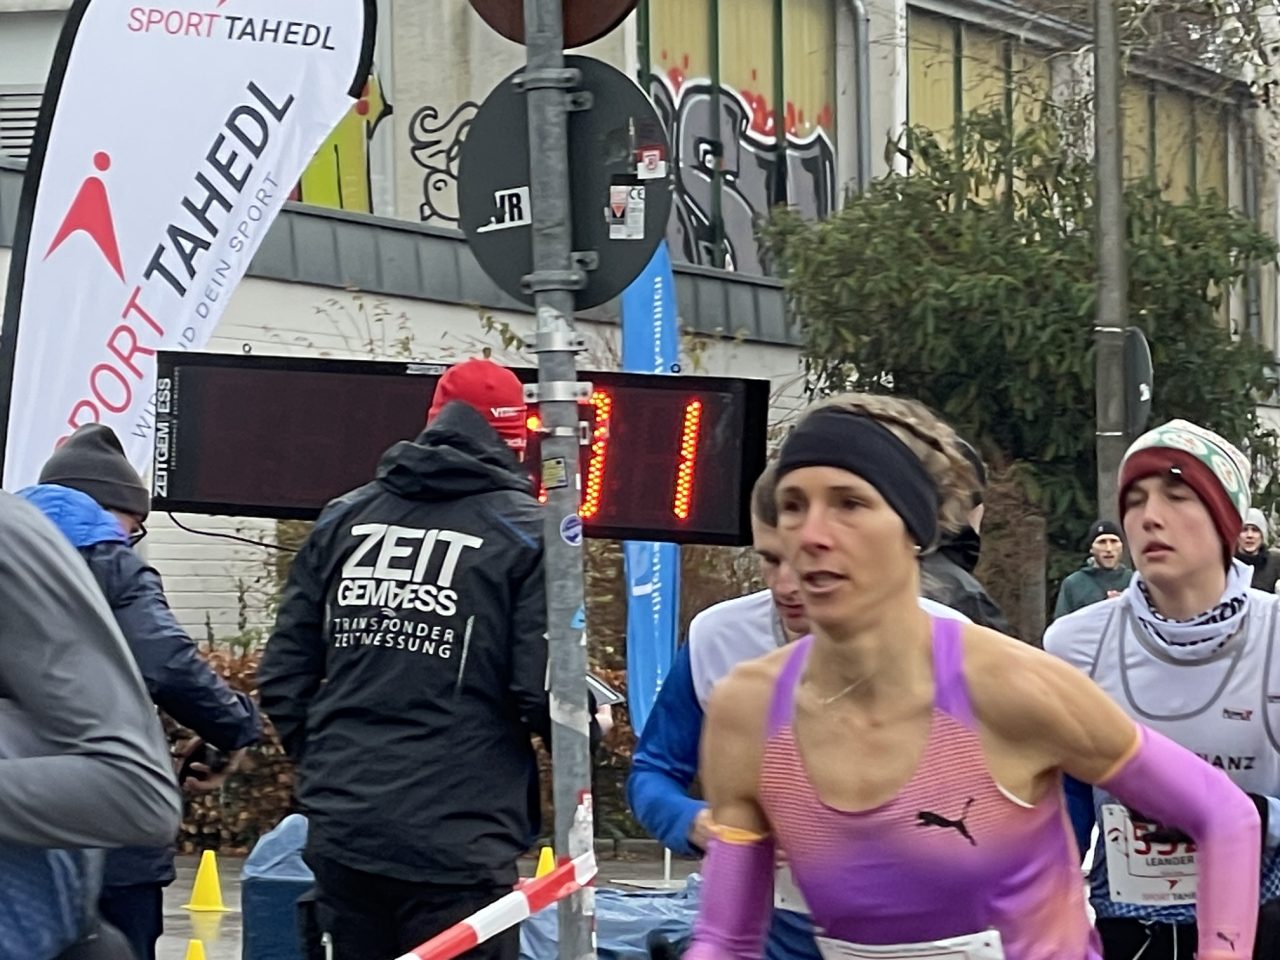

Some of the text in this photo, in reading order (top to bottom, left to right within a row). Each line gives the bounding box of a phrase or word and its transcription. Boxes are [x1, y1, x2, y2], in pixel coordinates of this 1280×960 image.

[127, 7, 336, 51] SPORT TAHEDL
[54, 80, 295, 449] PORT TAHEDL
[196, 259, 232, 319] DEIN
[229, 172, 279, 253] SPORT
[342, 523, 484, 588] ZEIT
[334, 618, 455, 642] TRANSPONDER
[334, 633, 452, 659] ZEITMESSUNG
[1145, 855, 1195, 867] LEANDER
